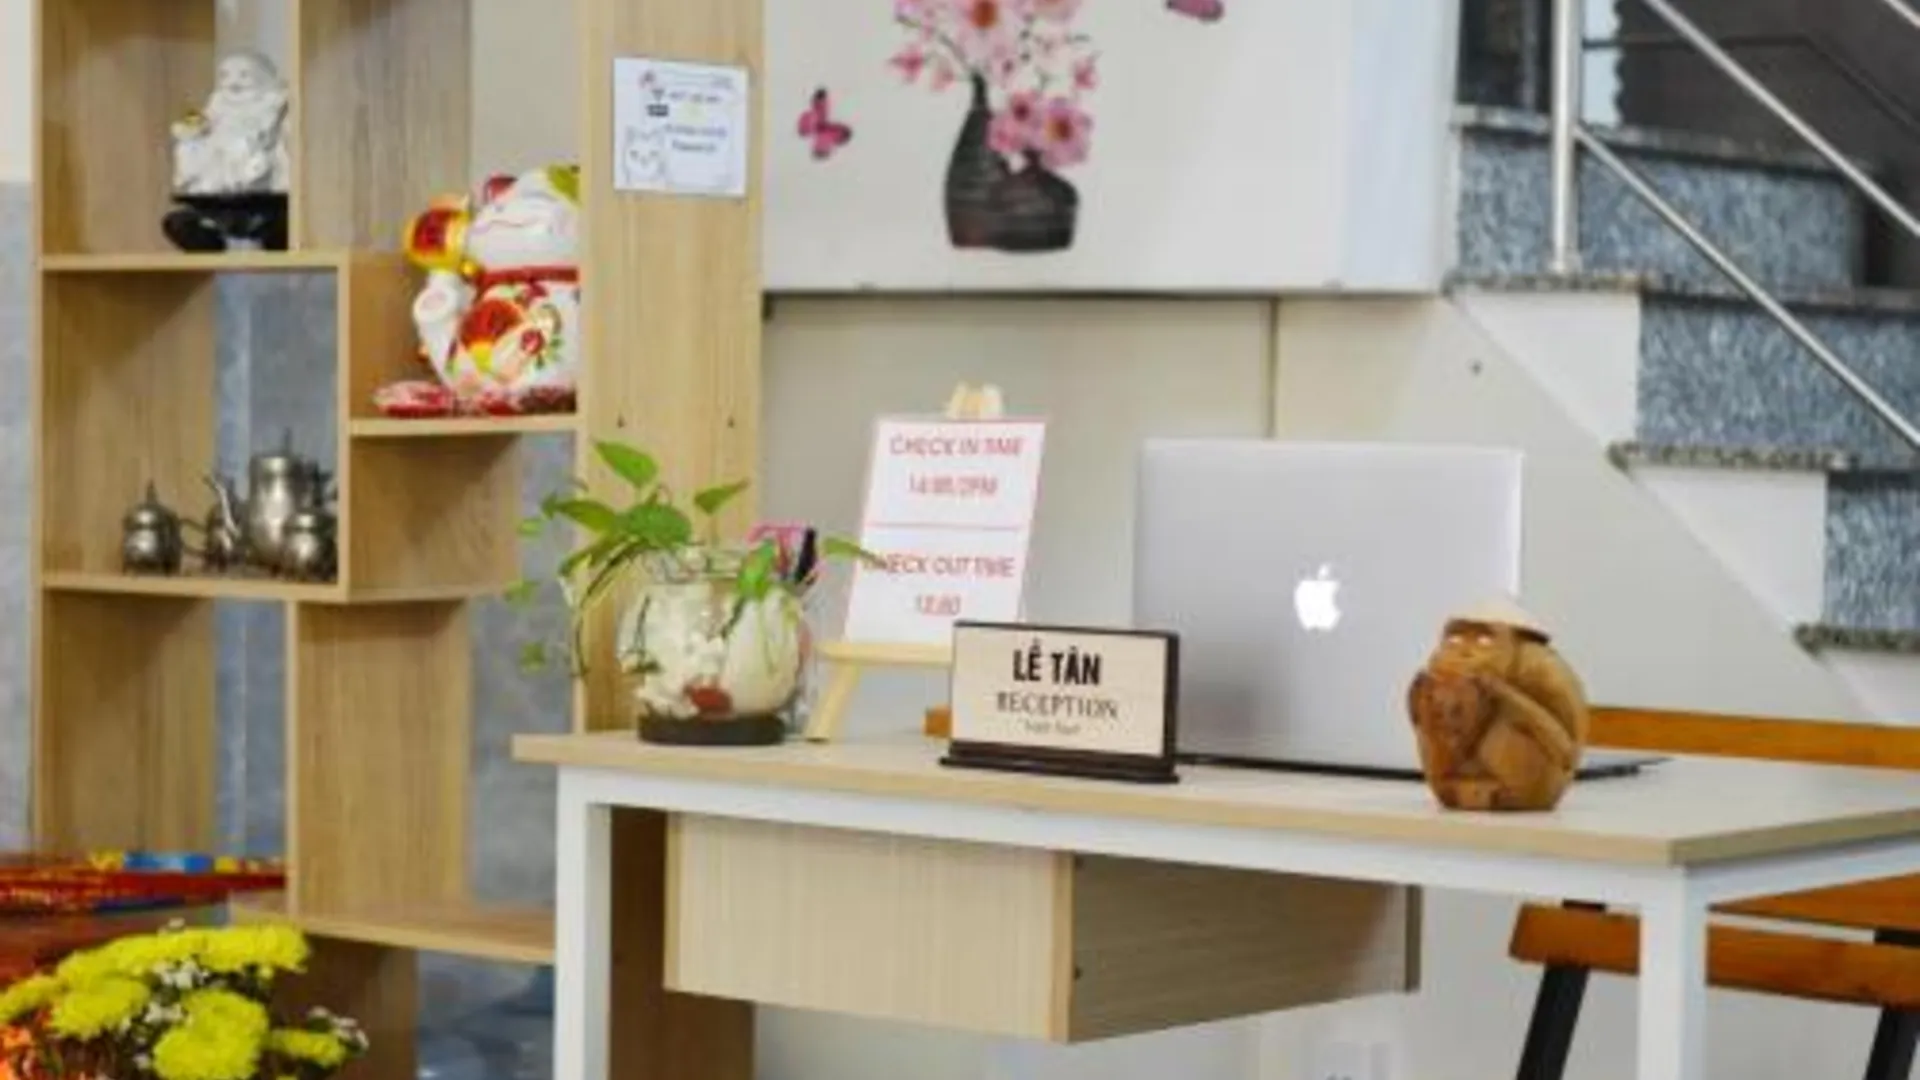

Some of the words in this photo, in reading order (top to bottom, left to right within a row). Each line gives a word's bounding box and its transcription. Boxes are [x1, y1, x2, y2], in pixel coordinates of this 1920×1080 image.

[889, 436, 954, 456] CHECK
[955, 437, 979, 455] IN
[932, 556, 972, 576] OUT
[1050, 645, 1102, 685] TÂN
[996, 691, 1118, 719] RECEPTION
